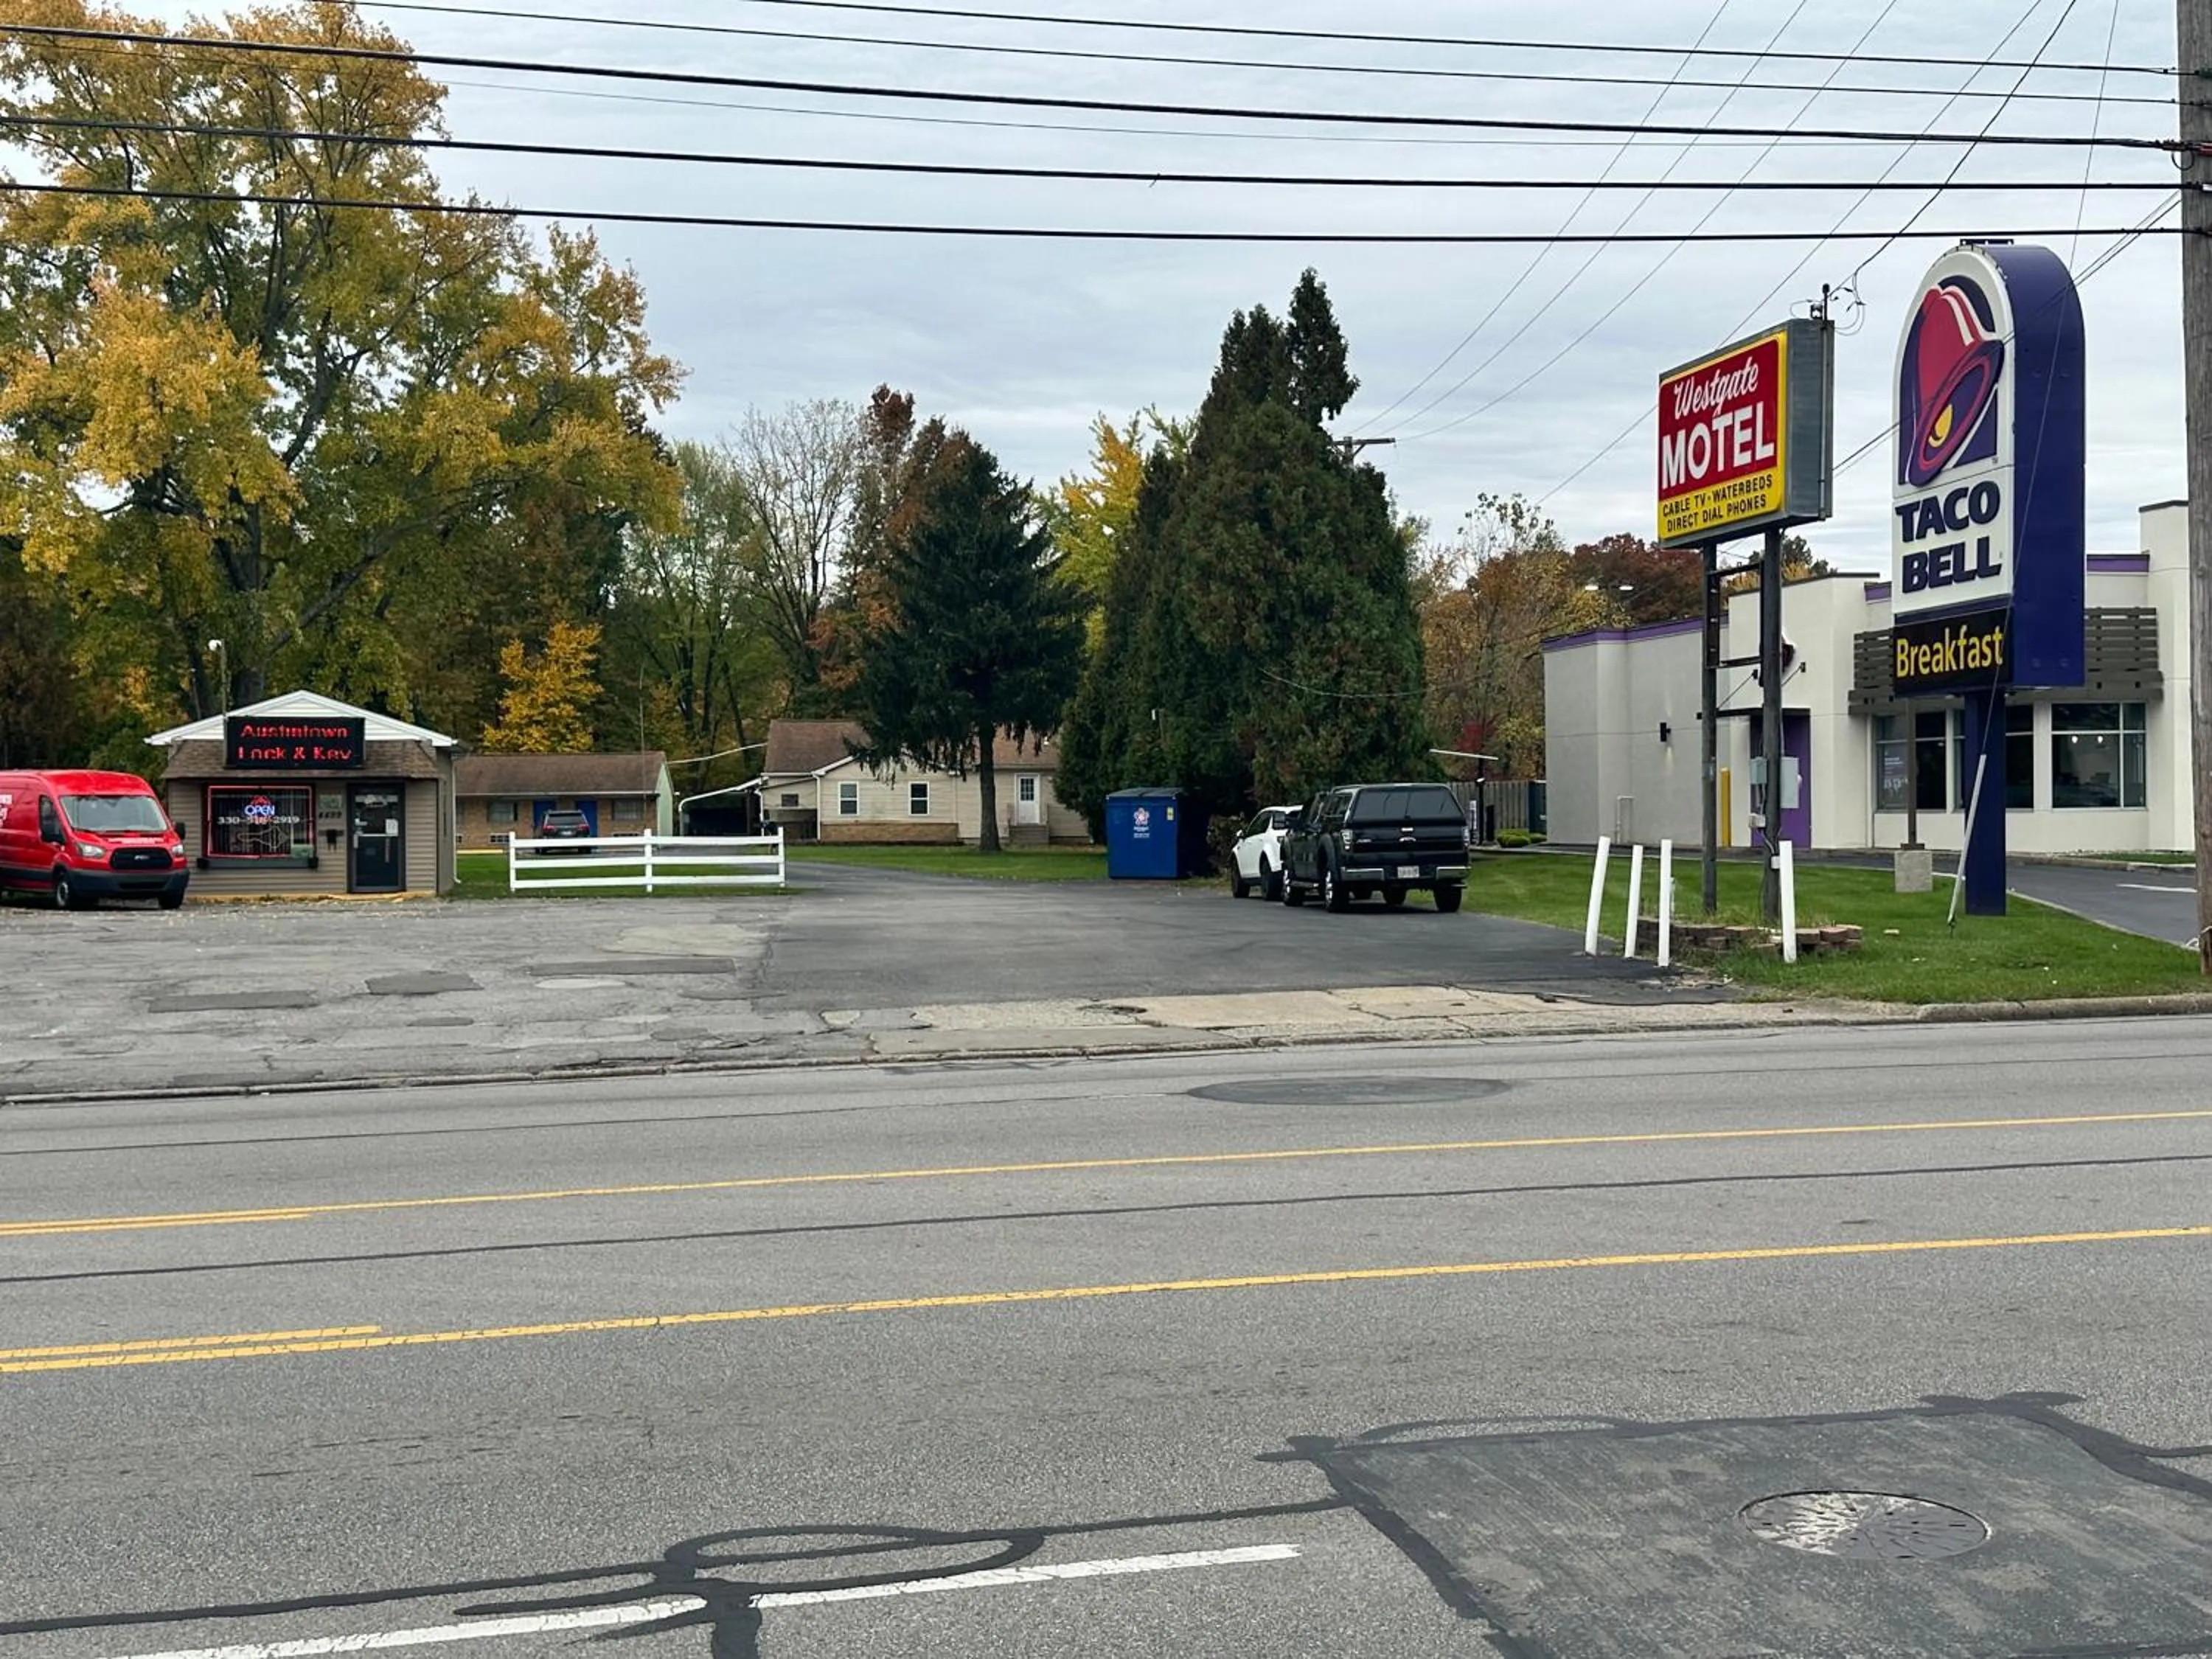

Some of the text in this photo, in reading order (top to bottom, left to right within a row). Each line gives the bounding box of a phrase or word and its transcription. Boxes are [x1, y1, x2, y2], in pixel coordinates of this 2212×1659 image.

[1674, 356, 1759, 420] Westgate
[1661, 401, 1774, 490] MOTEL
[1663, 498, 1690, 516] CABLE
[1694, 493, 1708, 508] TV
[1712, 474, 1773, 502] WATERBEDS
[1667, 495, 1766, 532] DIRECT DIAL PHONES
[1895, 481, 2000, 543] TACO
[1902, 536, 2002, 594] BELL
[1896, 625, 2003, 678] Breakfast
[240, 725, 348, 738] Austintown
[293, 747, 306, 759] &
[244, 804, 275, 815] OPEN
